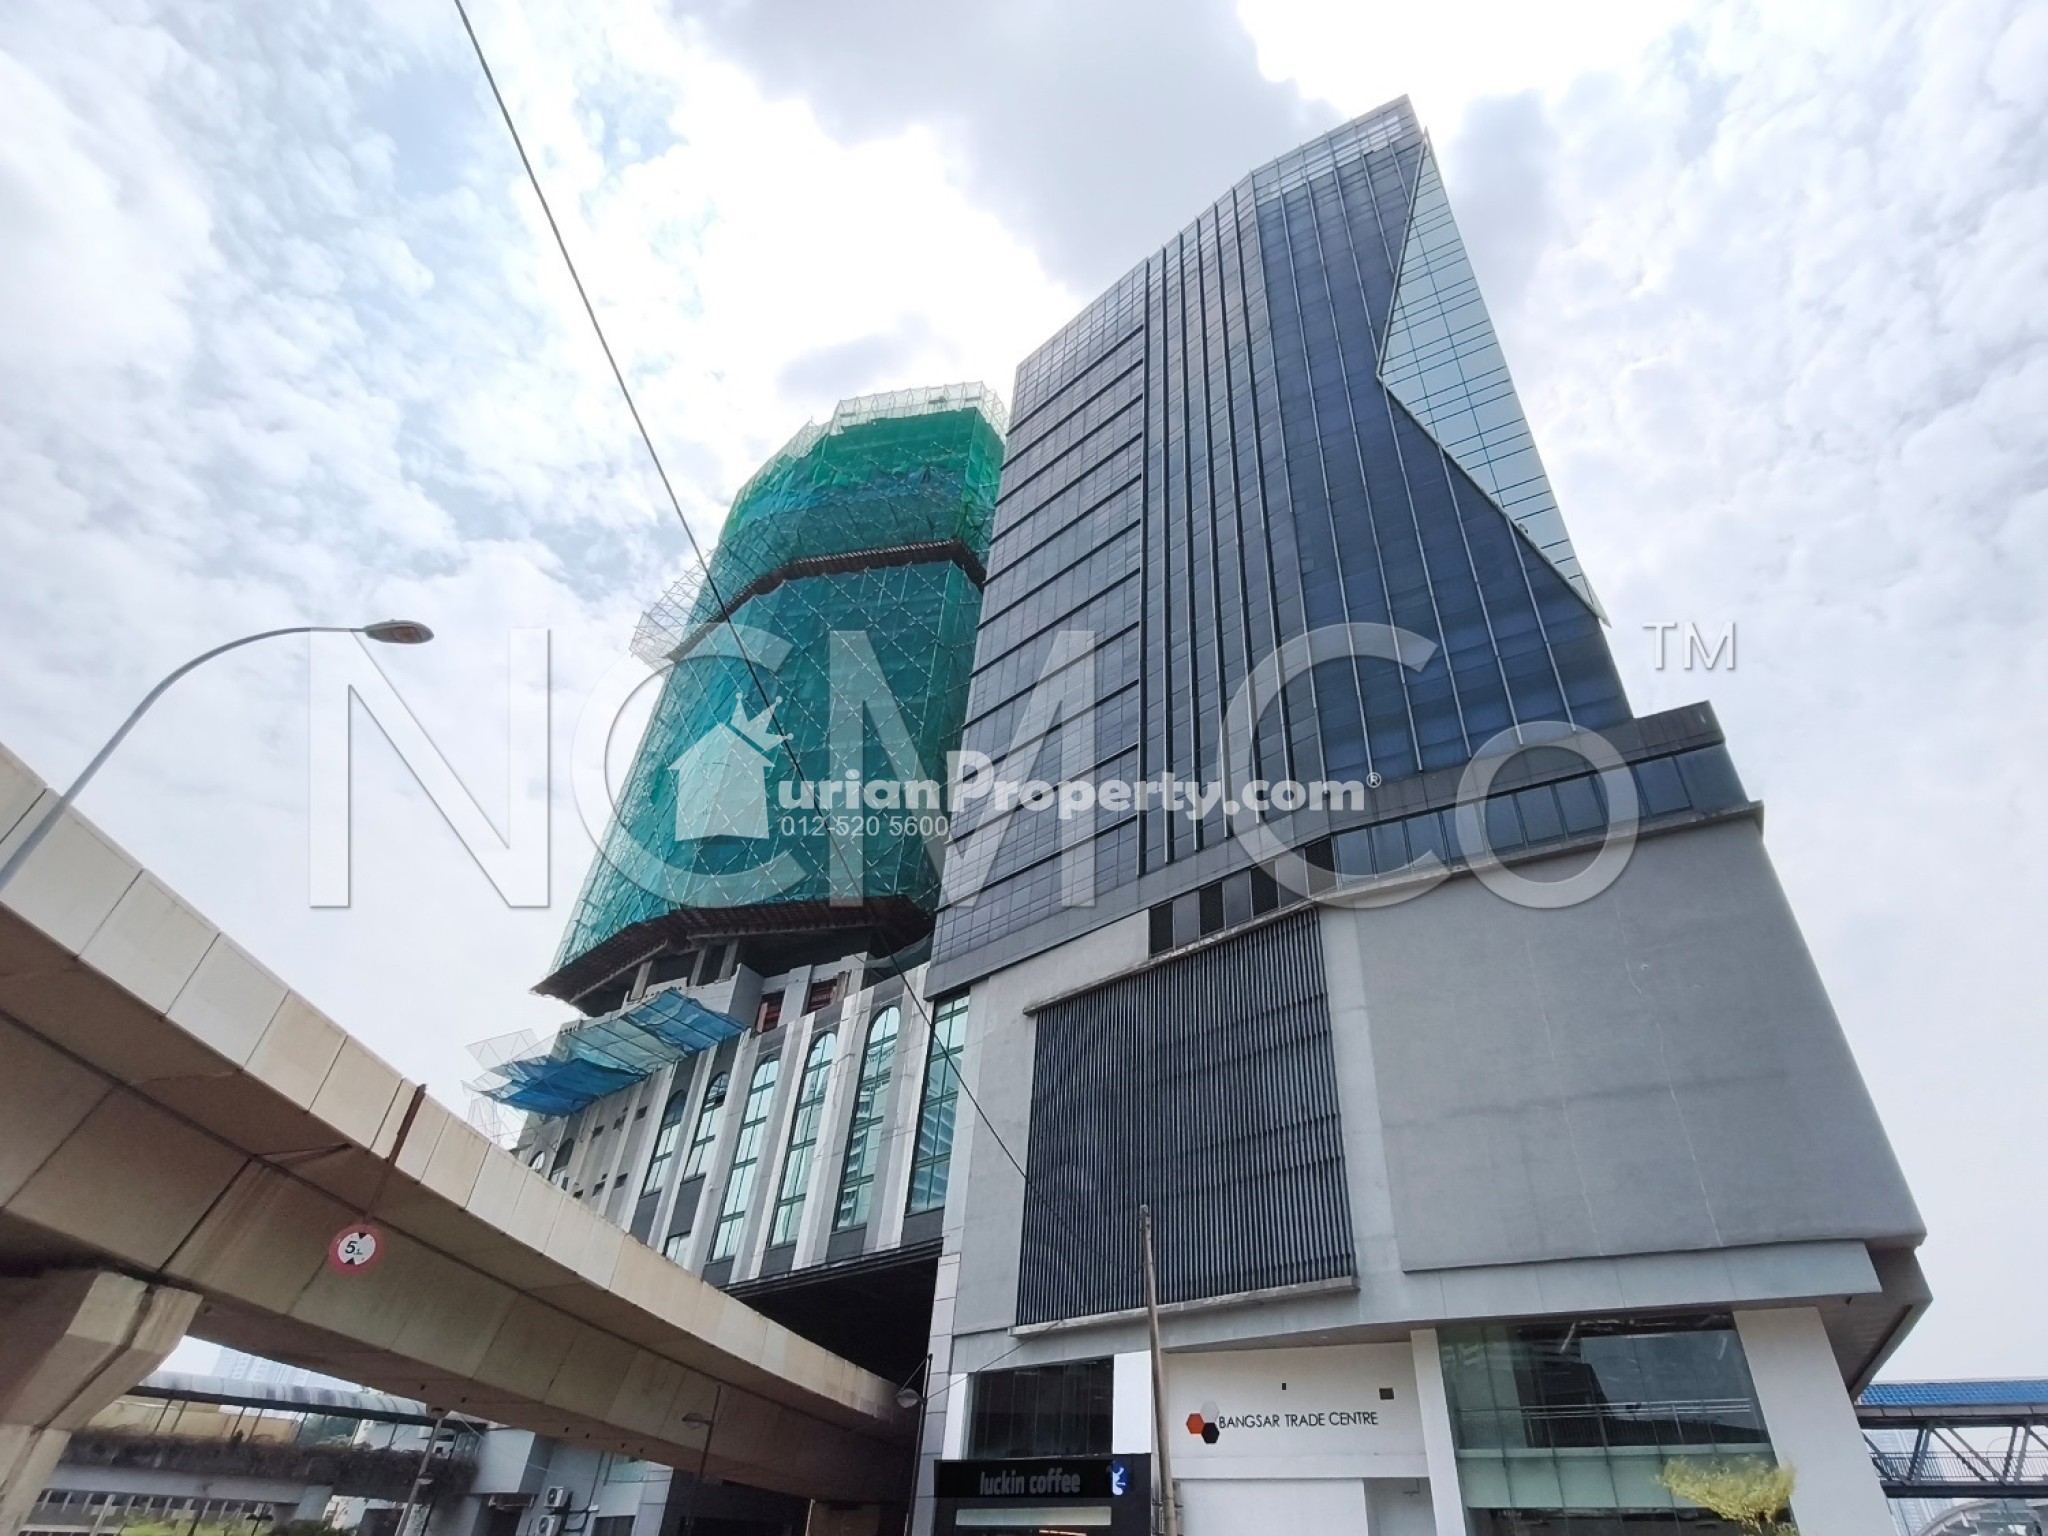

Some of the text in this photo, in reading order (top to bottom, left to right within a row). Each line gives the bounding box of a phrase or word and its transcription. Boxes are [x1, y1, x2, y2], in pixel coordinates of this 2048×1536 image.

[1218, 1411, 1379, 1429] BANGSAR TRADE CENTRE
[979, 1467, 1081, 1496] luckin coffee
